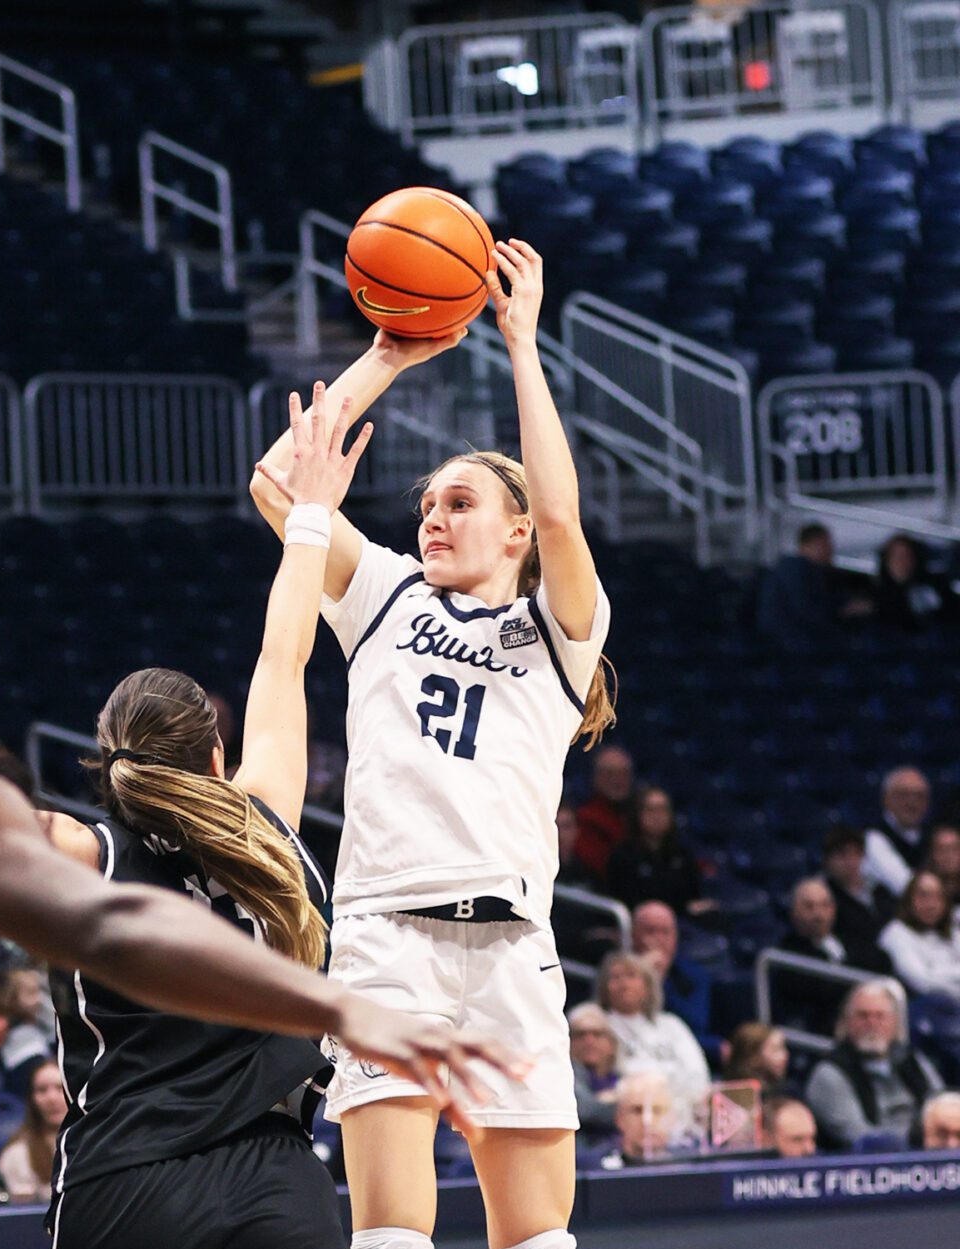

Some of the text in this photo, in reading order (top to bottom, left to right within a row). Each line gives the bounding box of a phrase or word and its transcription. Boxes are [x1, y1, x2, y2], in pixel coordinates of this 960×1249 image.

[785, 410, 862, 454] 208
[503, 634, 537, 648] CHANGE
[416, 673, 487, 761] 21
[454, 899, 474, 918] B
[732, 1161, 960, 1201] HINKLE FIELDHOUS
